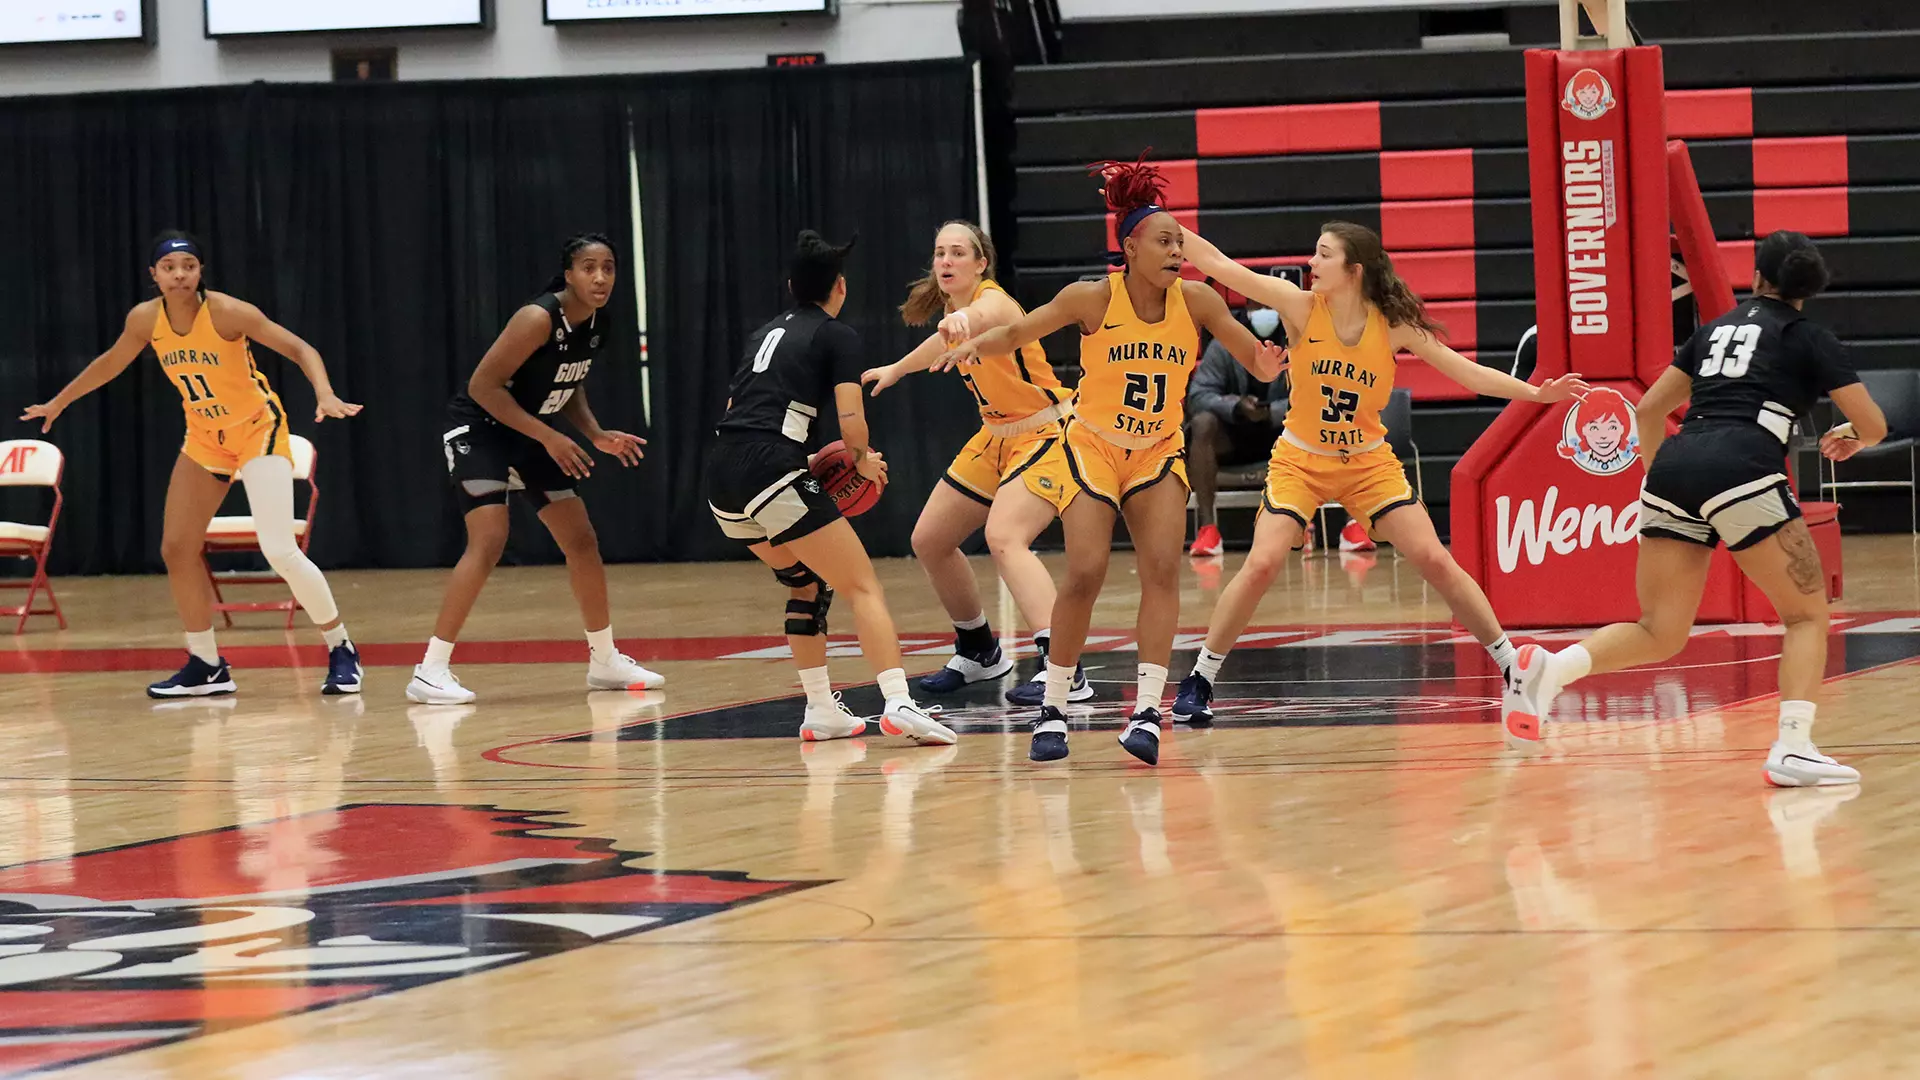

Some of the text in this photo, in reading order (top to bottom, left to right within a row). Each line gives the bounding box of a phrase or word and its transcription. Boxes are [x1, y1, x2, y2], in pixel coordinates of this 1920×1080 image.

[1603, 146, 1614, 218] BASKETBALL
[1562, 139, 1609, 335] GOVERNORS
[162, 349, 220, 368] MURRAY
[752, 327, 787, 374] 0
[1107, 341, 1187, 366] MURRAY
[1698, 323, 1763, 378] 33
[553, 358, 592, 383] GOVS
[1311, 359, 1377, 388] MURRAY
[177, 373, 216, 404] 11
[1122, 371, 1168, 413] 21
[1320, 384, 1361, 423] 32
[1114, 412, 1165, 435] STATE
[1319, 428, 1364, 445] STATE
